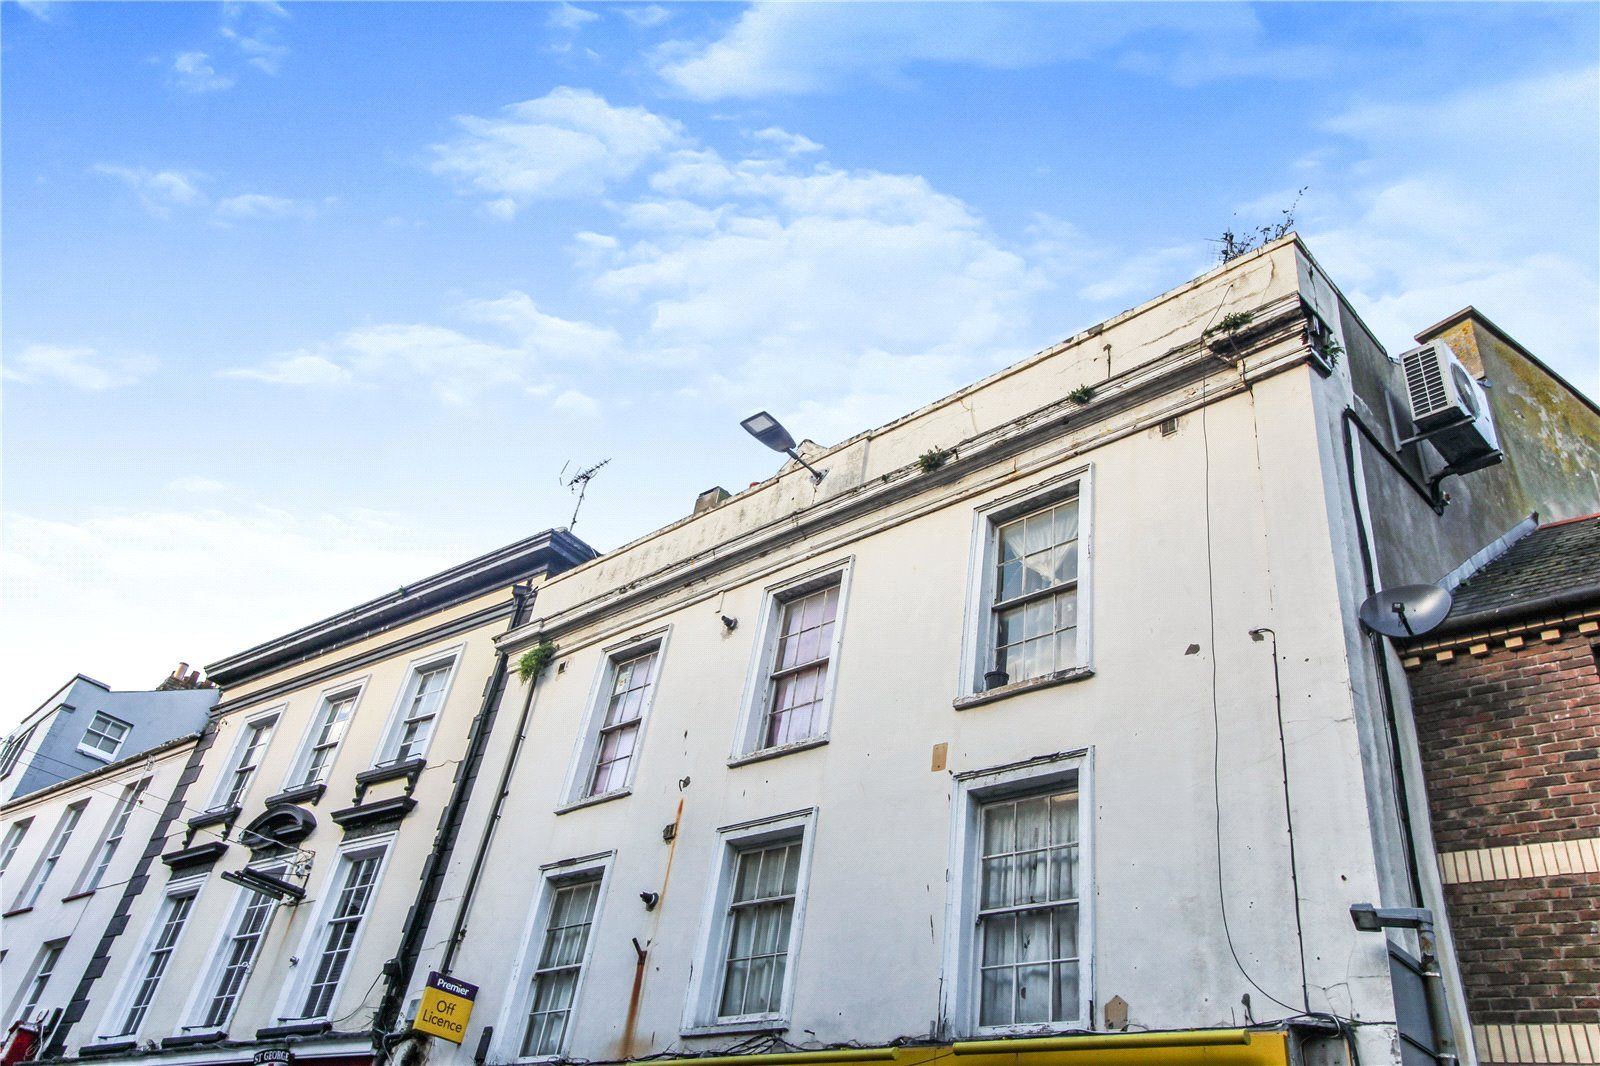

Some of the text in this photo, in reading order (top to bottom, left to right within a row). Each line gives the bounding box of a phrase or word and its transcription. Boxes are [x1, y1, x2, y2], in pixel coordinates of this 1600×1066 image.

[437, 978, 470, 996] Premier
[436, 1000, 457, 1016] Off
[422, 1009, 463, 1033] Licence
